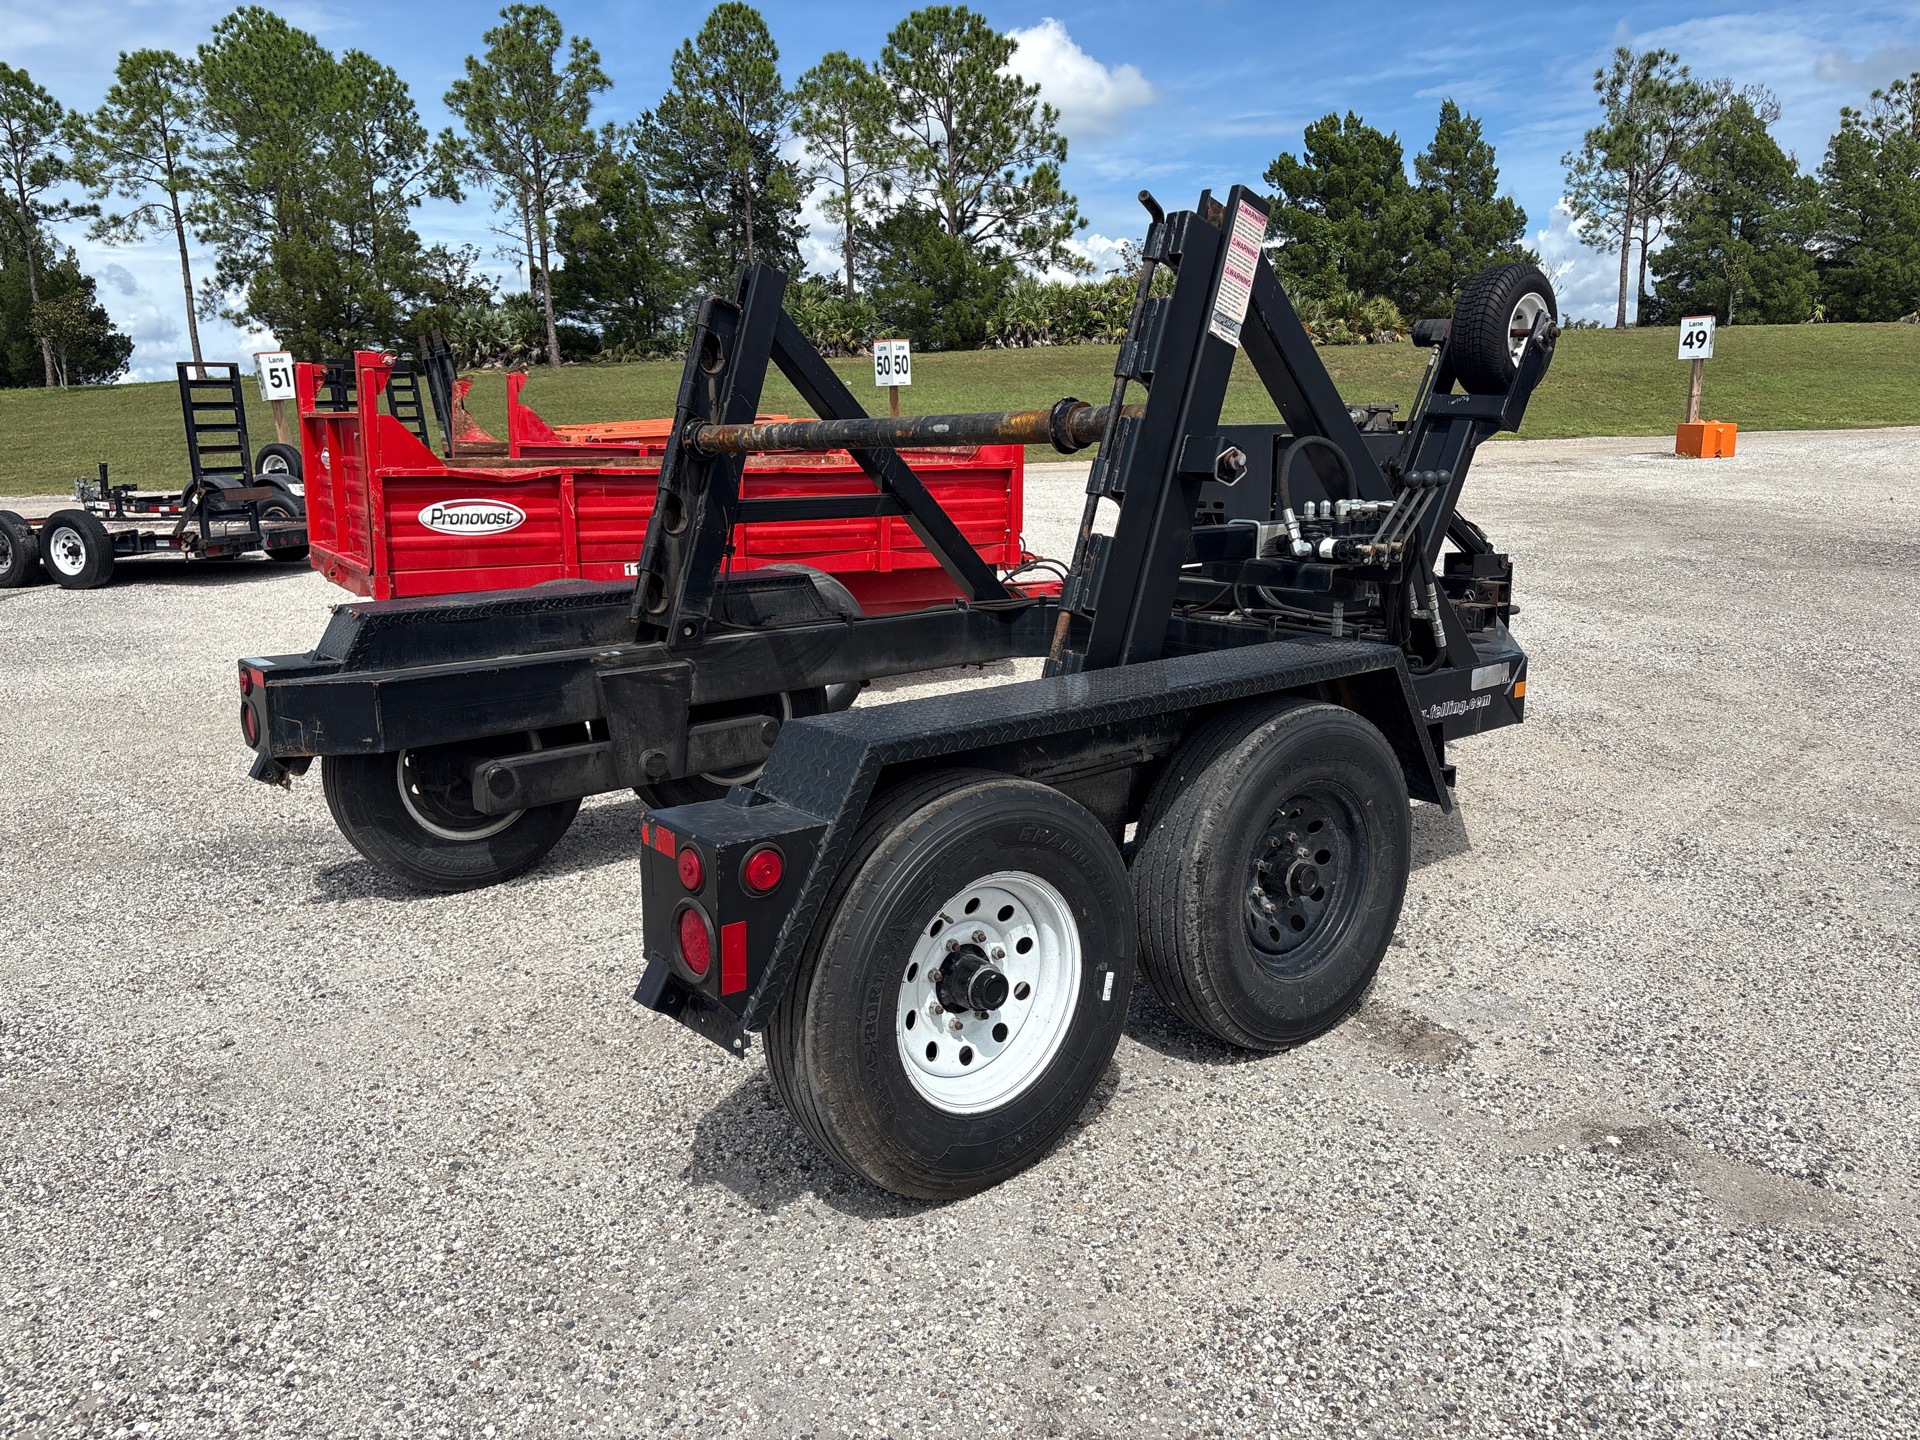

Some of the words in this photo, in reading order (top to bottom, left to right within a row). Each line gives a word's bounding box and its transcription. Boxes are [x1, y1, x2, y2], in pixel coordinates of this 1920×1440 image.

[1243, 207, 1266, 227] WARNING
[1235, 240, 1258, 260] WARNING
[1229, 267, 1251, 288] WARNING
[1682, 330, 1708, 349] 49
[268, 356, 285, 364] Lane
[876, 355, 891, 376] 50
[894, 354, 909, 375] 50
[269, 367, 291, 389] 51
[430, 507, 514, 526] Pronovost
